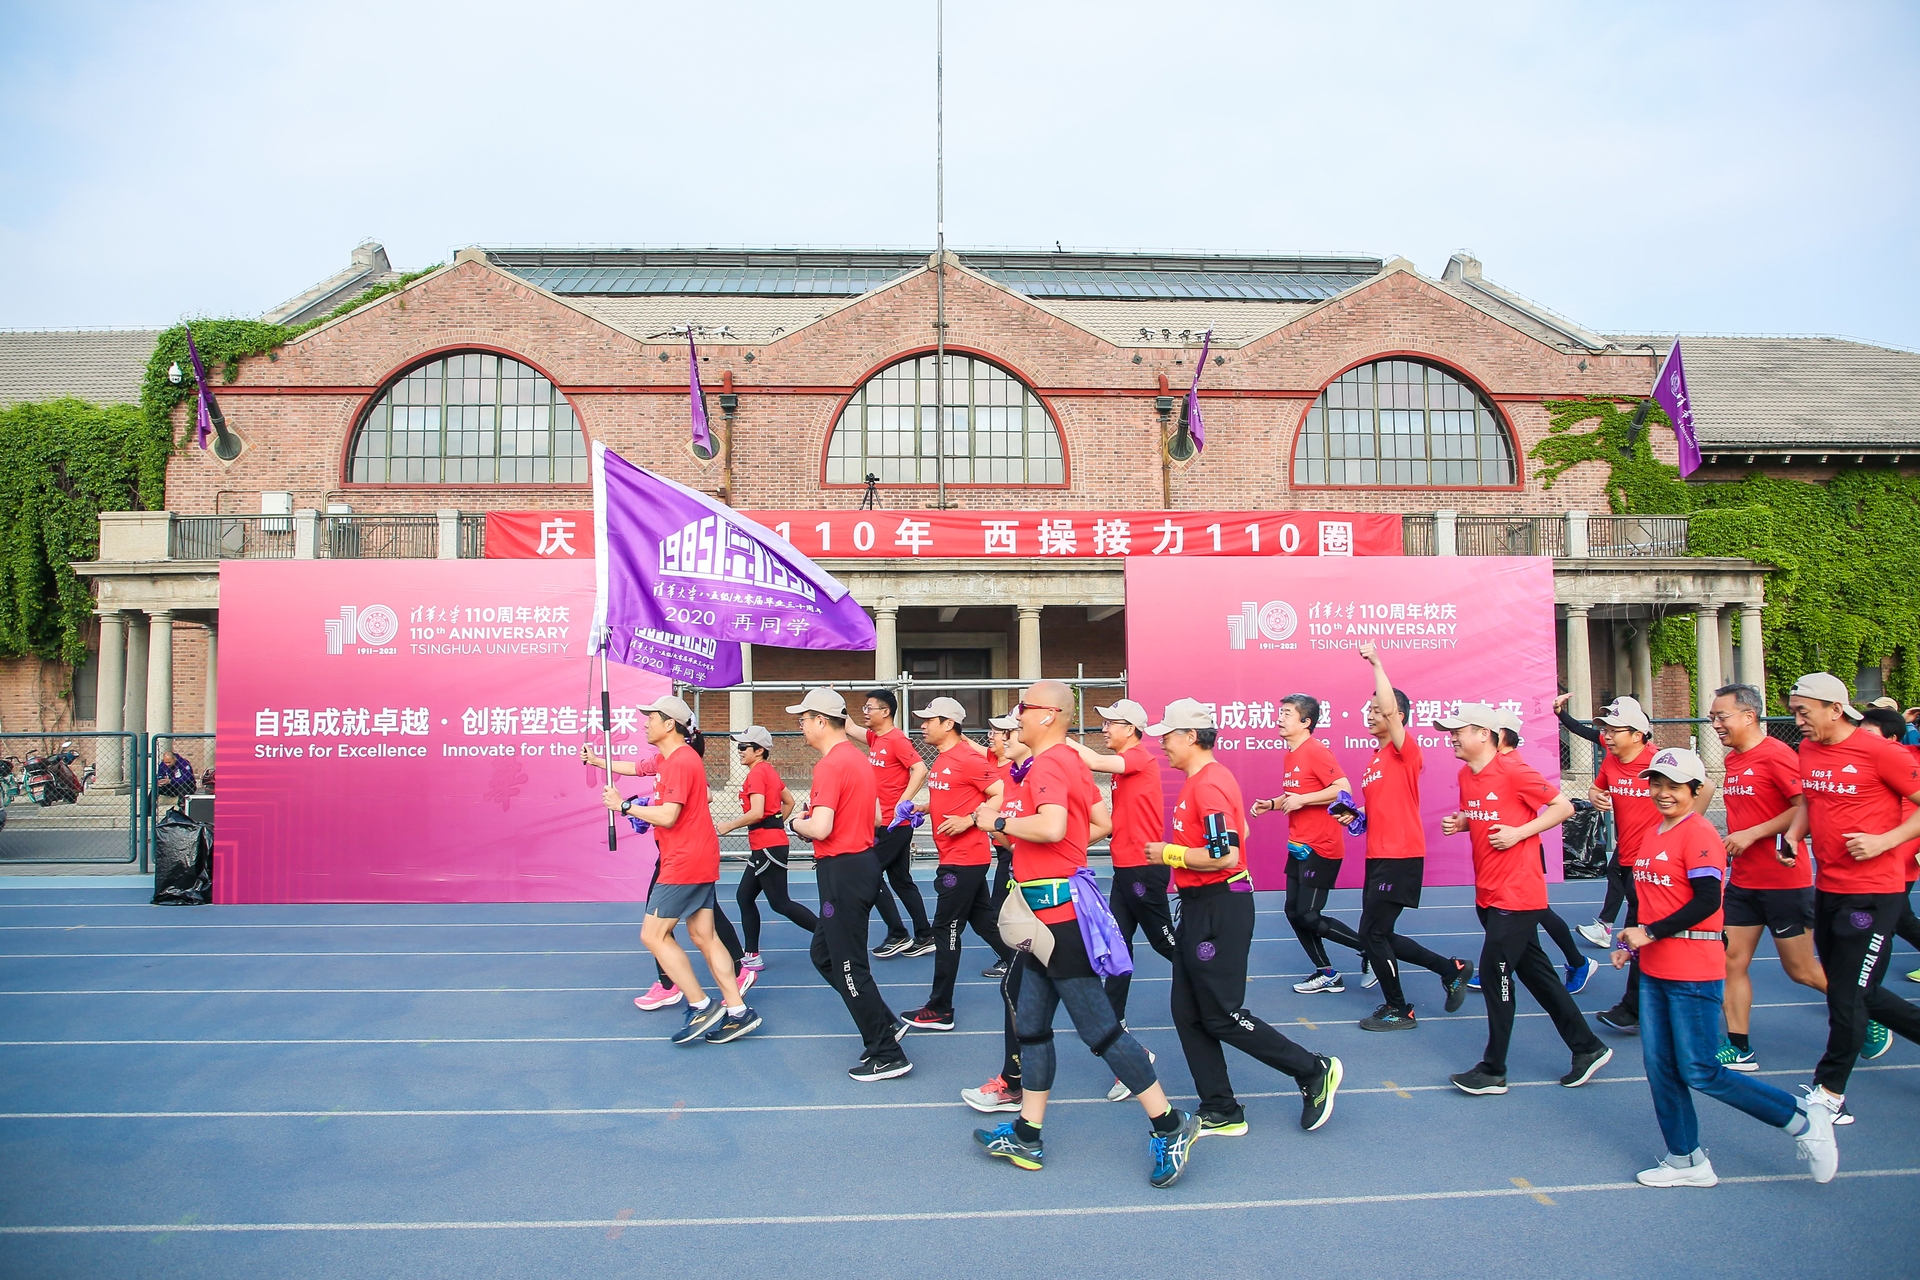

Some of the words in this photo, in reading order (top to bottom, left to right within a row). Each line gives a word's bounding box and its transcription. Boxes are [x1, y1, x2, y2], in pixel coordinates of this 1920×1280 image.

[464, 606, 570, 624] 110周年校庆
[1359, 603, 1457, 620] 110周年校庆
[664, 606, 716, 626] 2020
[731, 613, 810, 637] 再同学
[1309, 622, 1343, 635] 110th
[1345, 622, 1458, 635] ANNIVERSARY
[410, 627, 446, 640] 110th
[448, 626, 570, 640] ANNIVERSARY
[410, 643, 482, 655] TSINGHUA
[487, 643, 570, 655] UNIVERSITY
[1381, 638, 1458, 650] UNIVERSITY
[633, 653, 664, 669] 2020
[254, 743, 303, 758] Strive
[308, 743, 333, 758] for
[338, 743, 427, 758] Excellence
[443, 743, 516, 758] Innovate
[520, 743, 545, 757] for
[549, 742, 577, 756] the
[582, 742, 638, 756] uure
[1217, 736, 1241, 750] for
[1417, 735, 1440, 748] for
[1872, 932, 1884, 953] 110
[843, 959, 851, 972] 110
[1858, 953, 1880, 988] YEARS
[845, 973, 859, 998] YEARS
